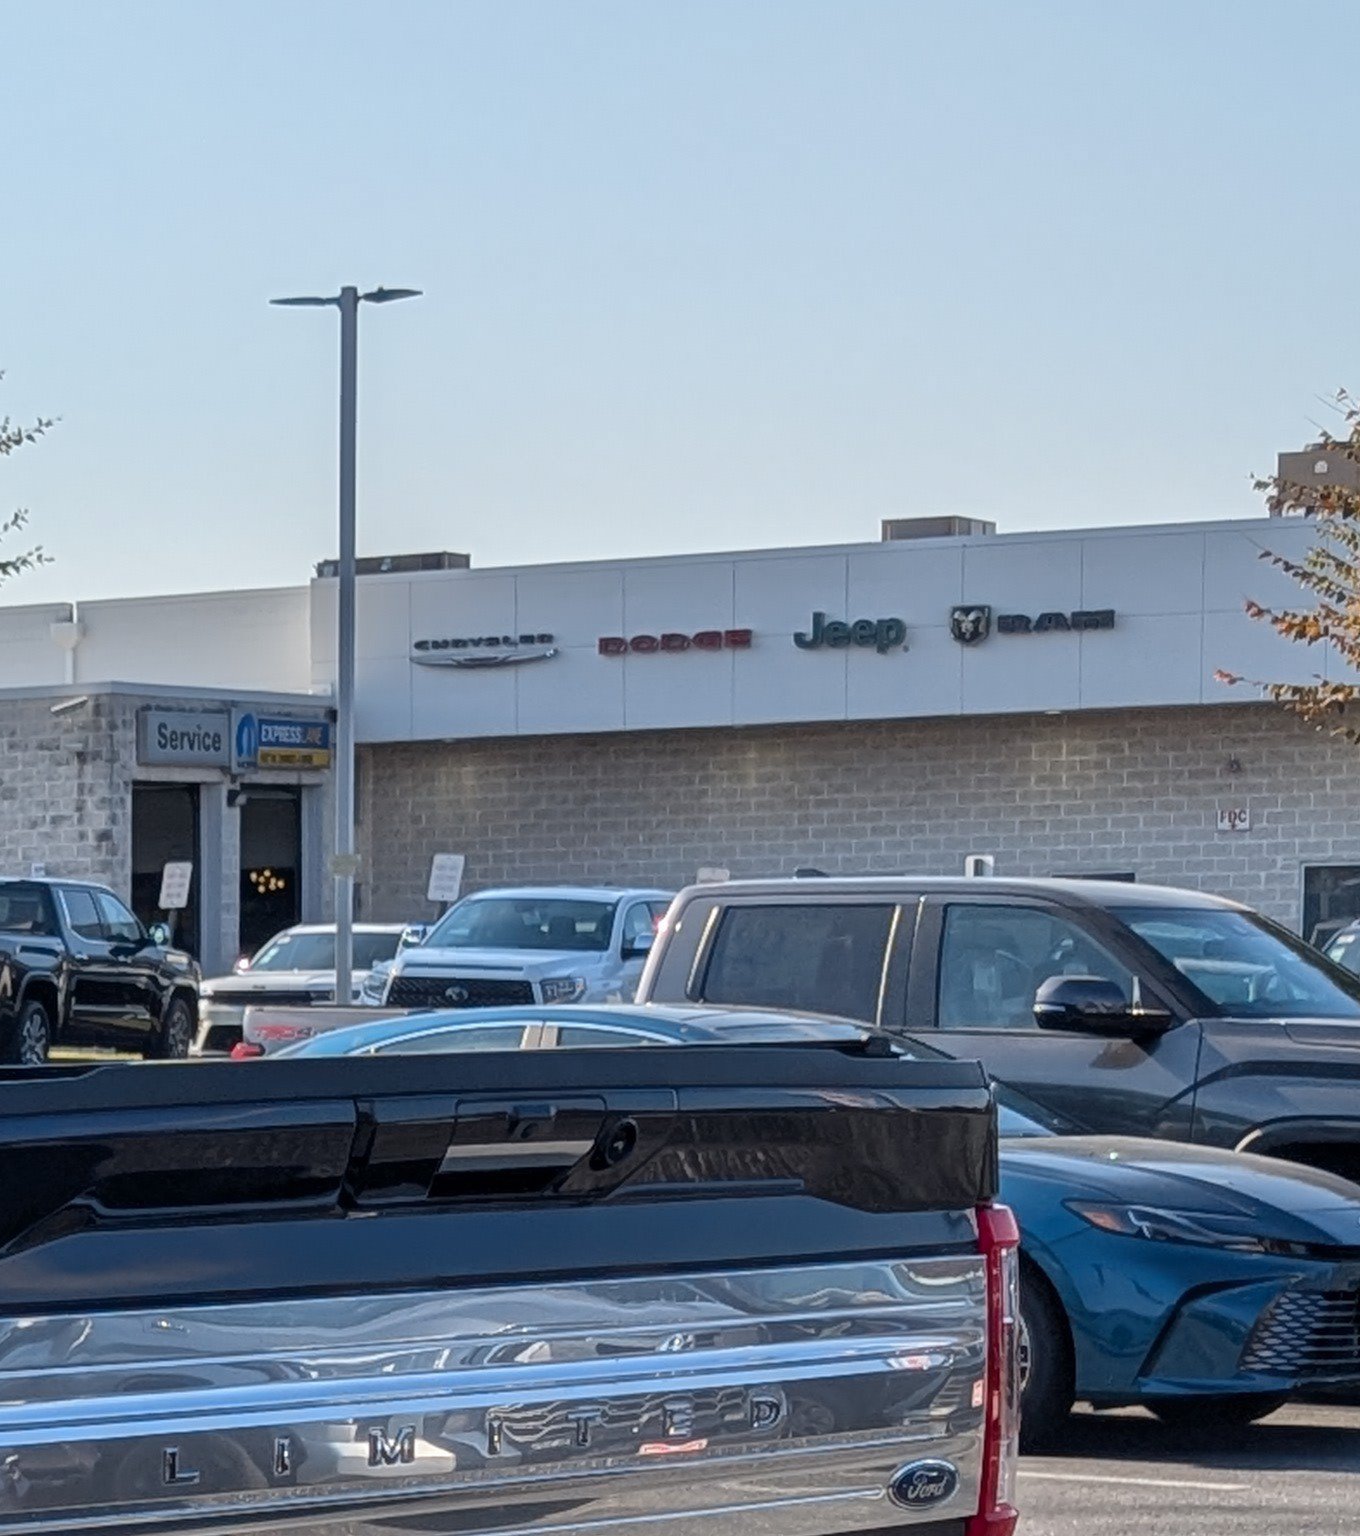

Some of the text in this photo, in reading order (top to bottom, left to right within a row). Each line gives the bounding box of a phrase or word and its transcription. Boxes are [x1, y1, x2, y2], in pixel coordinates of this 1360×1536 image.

[793, 611, 907, 654] Jeep
[996, 609, 1116, 634] RAM
[597, 629, 753, 656] DODGE
[157, 722, 222, 752] Service
[162, 1388, 790, 1487] LIMITED
[906, 1470, 948, 1500] Ford
